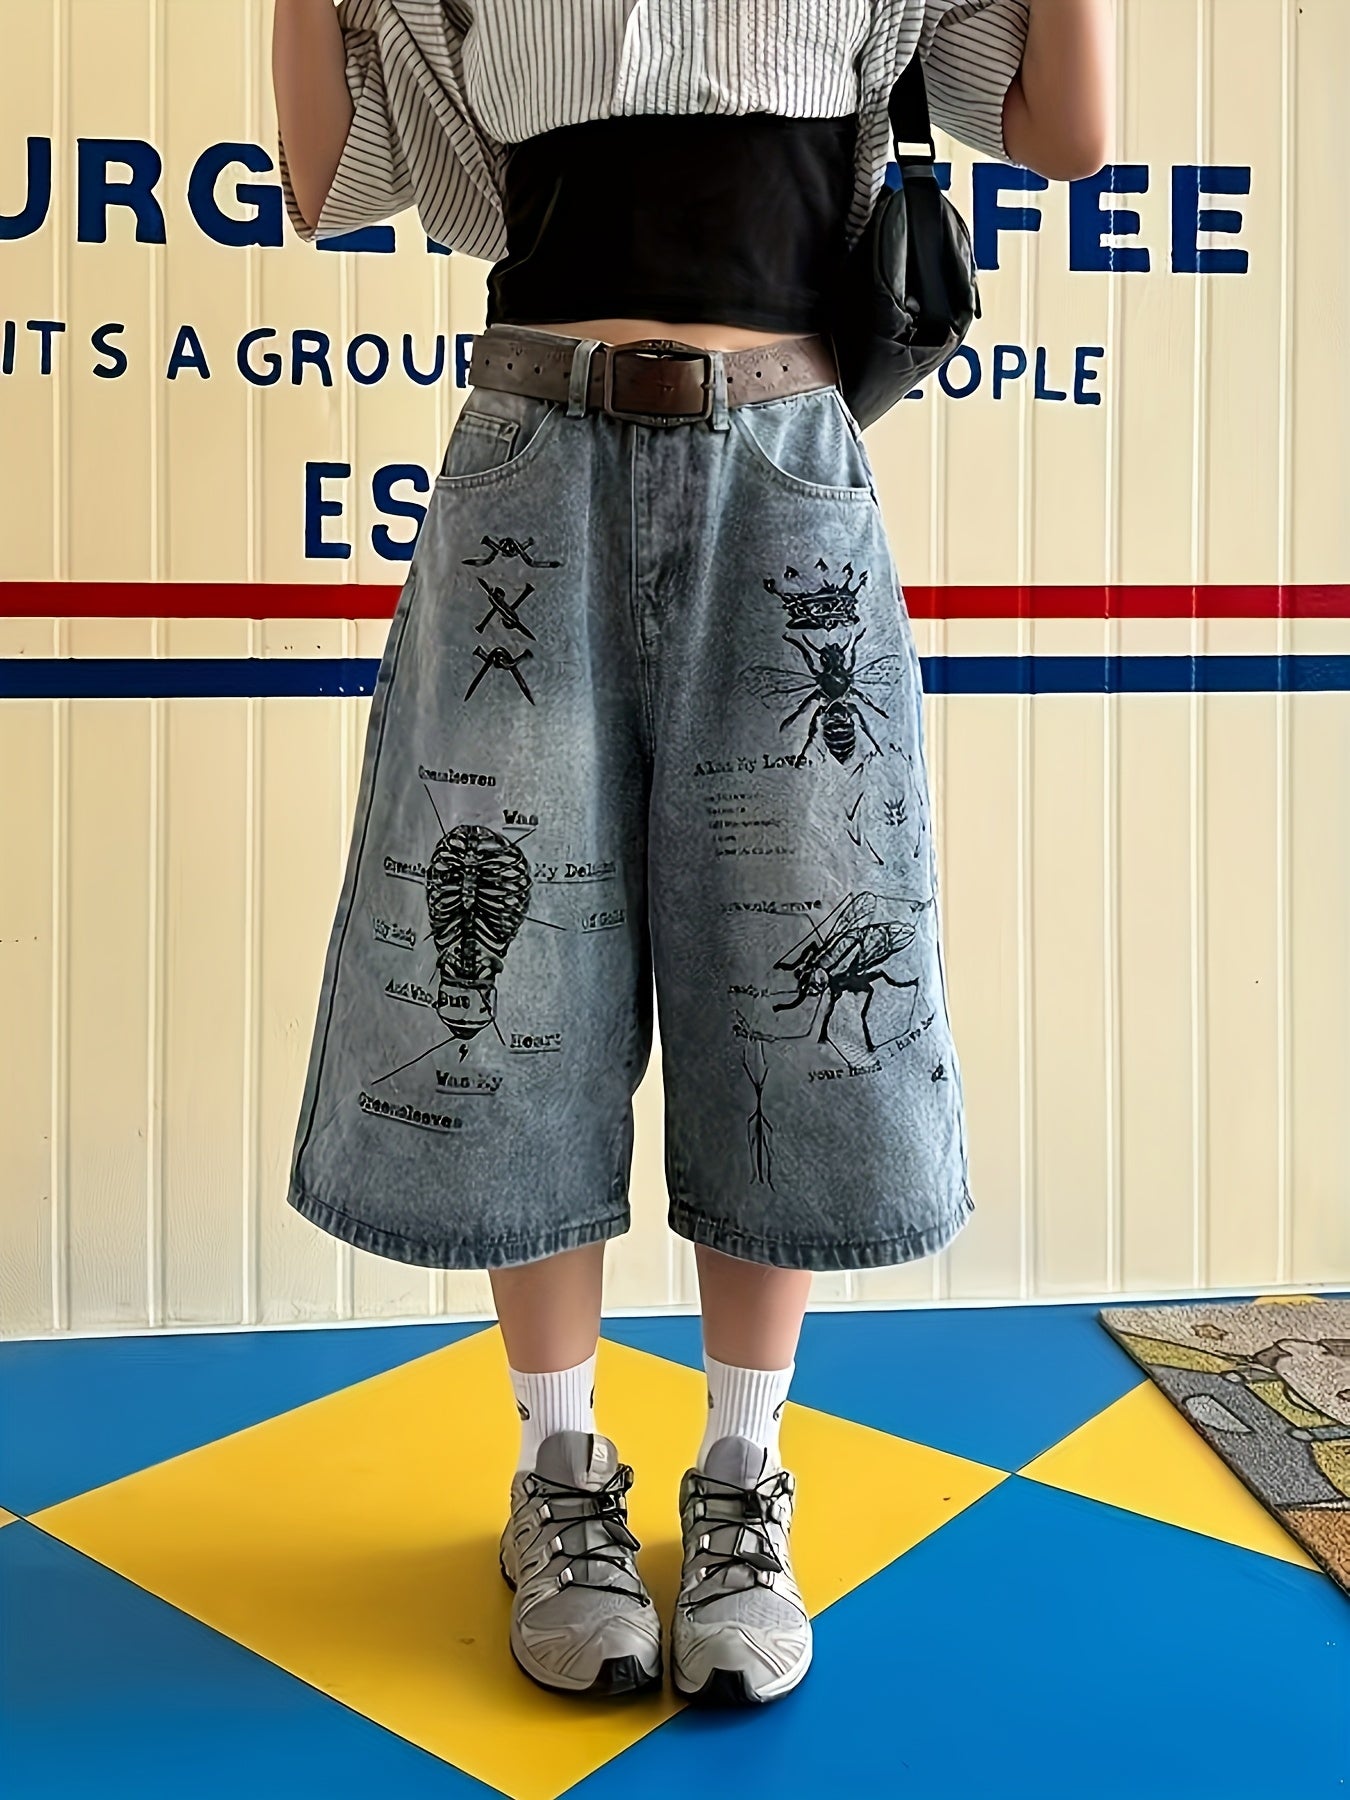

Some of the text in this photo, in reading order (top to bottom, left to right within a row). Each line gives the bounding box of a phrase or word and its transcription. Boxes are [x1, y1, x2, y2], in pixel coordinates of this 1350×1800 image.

[0, 136, 453, 254] URG
[885, 162, 1252, 274] FEE
[166, 324, 212, 381] A
[903, 344, 1106, 407] OPLE
